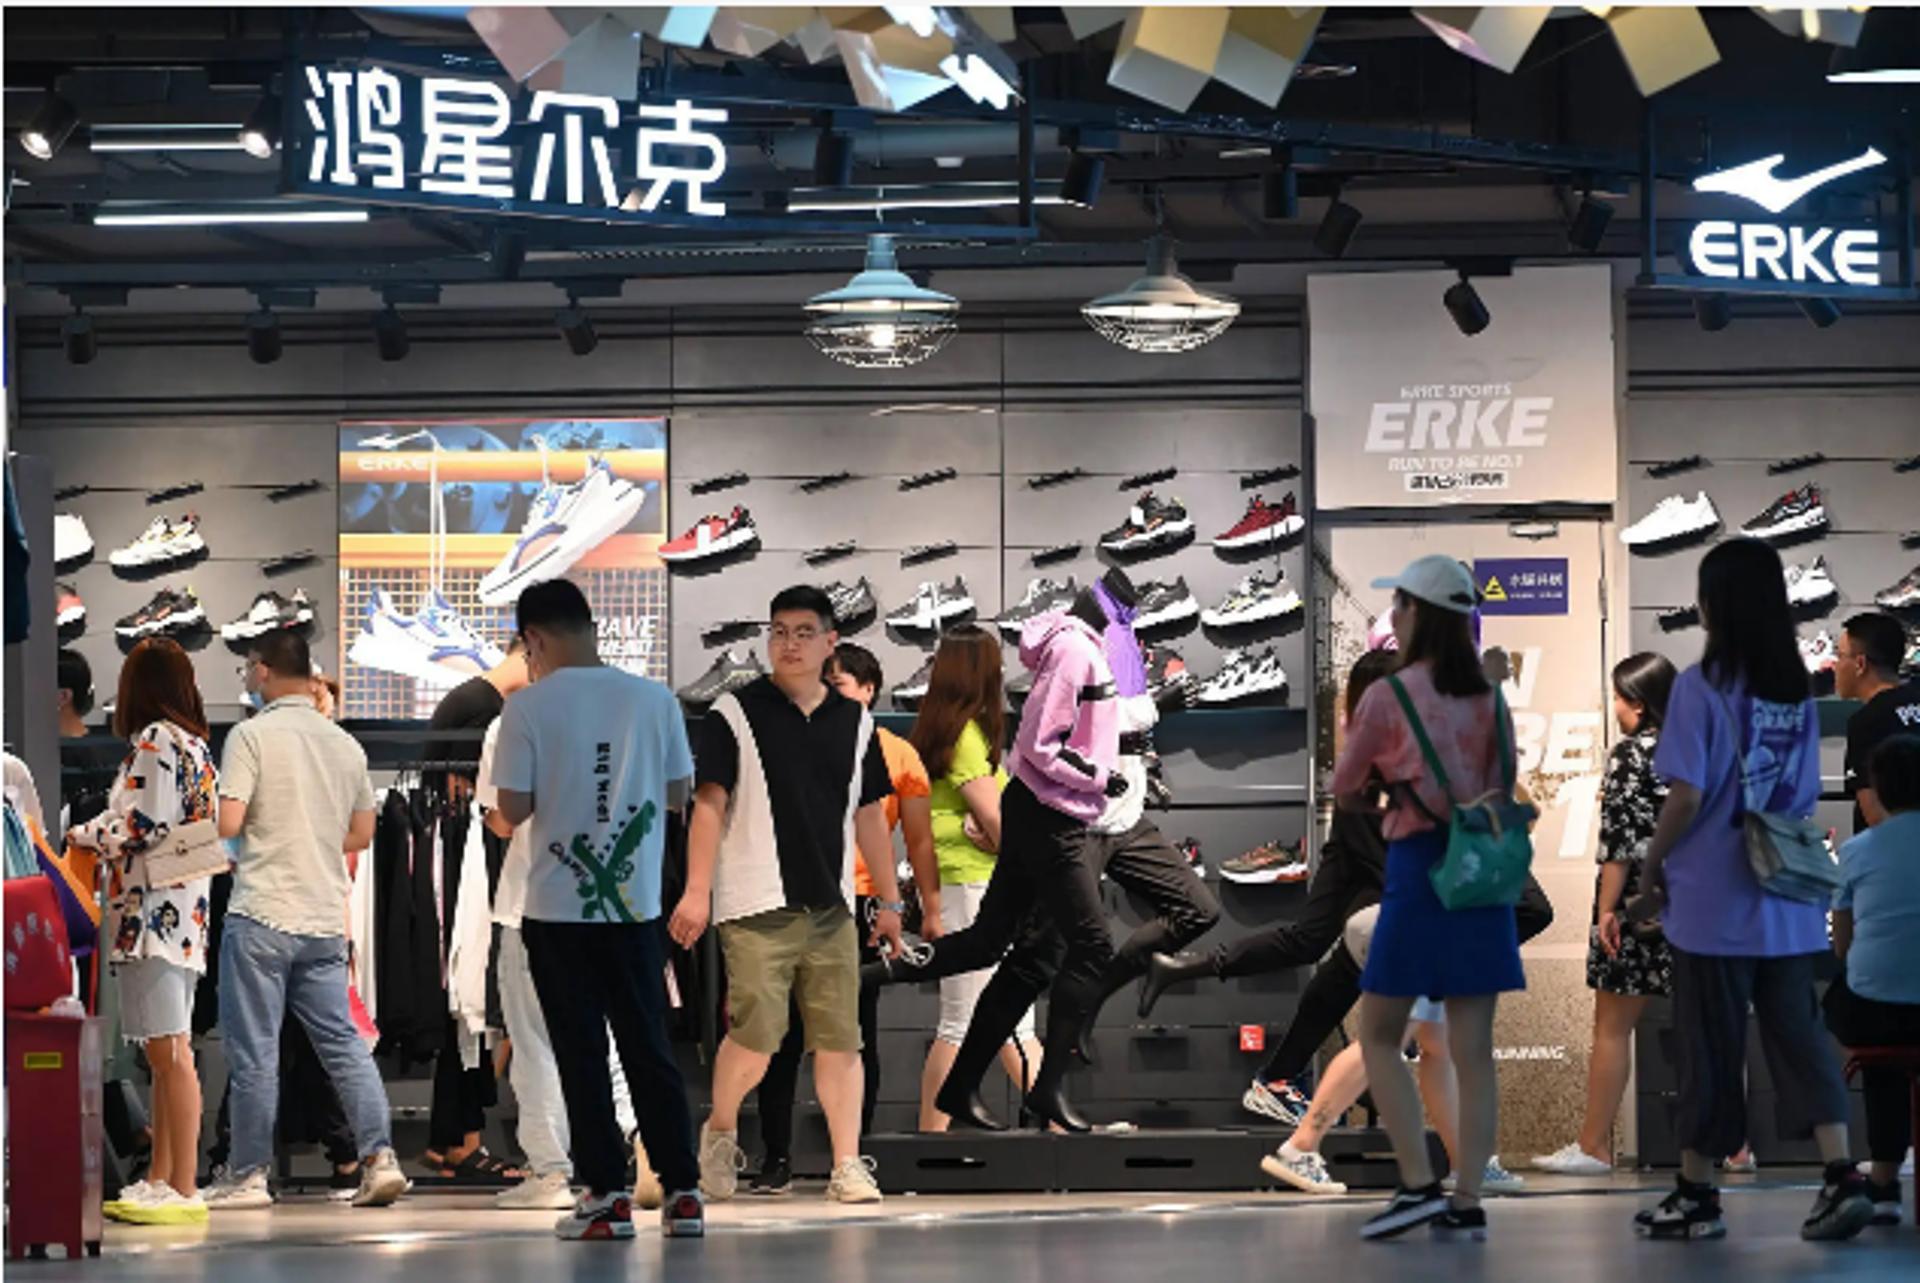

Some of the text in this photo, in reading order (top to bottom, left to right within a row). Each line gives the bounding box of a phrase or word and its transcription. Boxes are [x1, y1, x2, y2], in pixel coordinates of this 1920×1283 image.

[305, 66, 729, 217] 鸿星尔克
[1689, 220, 1880, 286] ERKE
[1449, 382, 1512, 398] SPORTS
[1364, 396, 1554, 453] ERKE
[1388, 458, 1426, 472] RUN
[1429, 456, 1454, 471] TO
